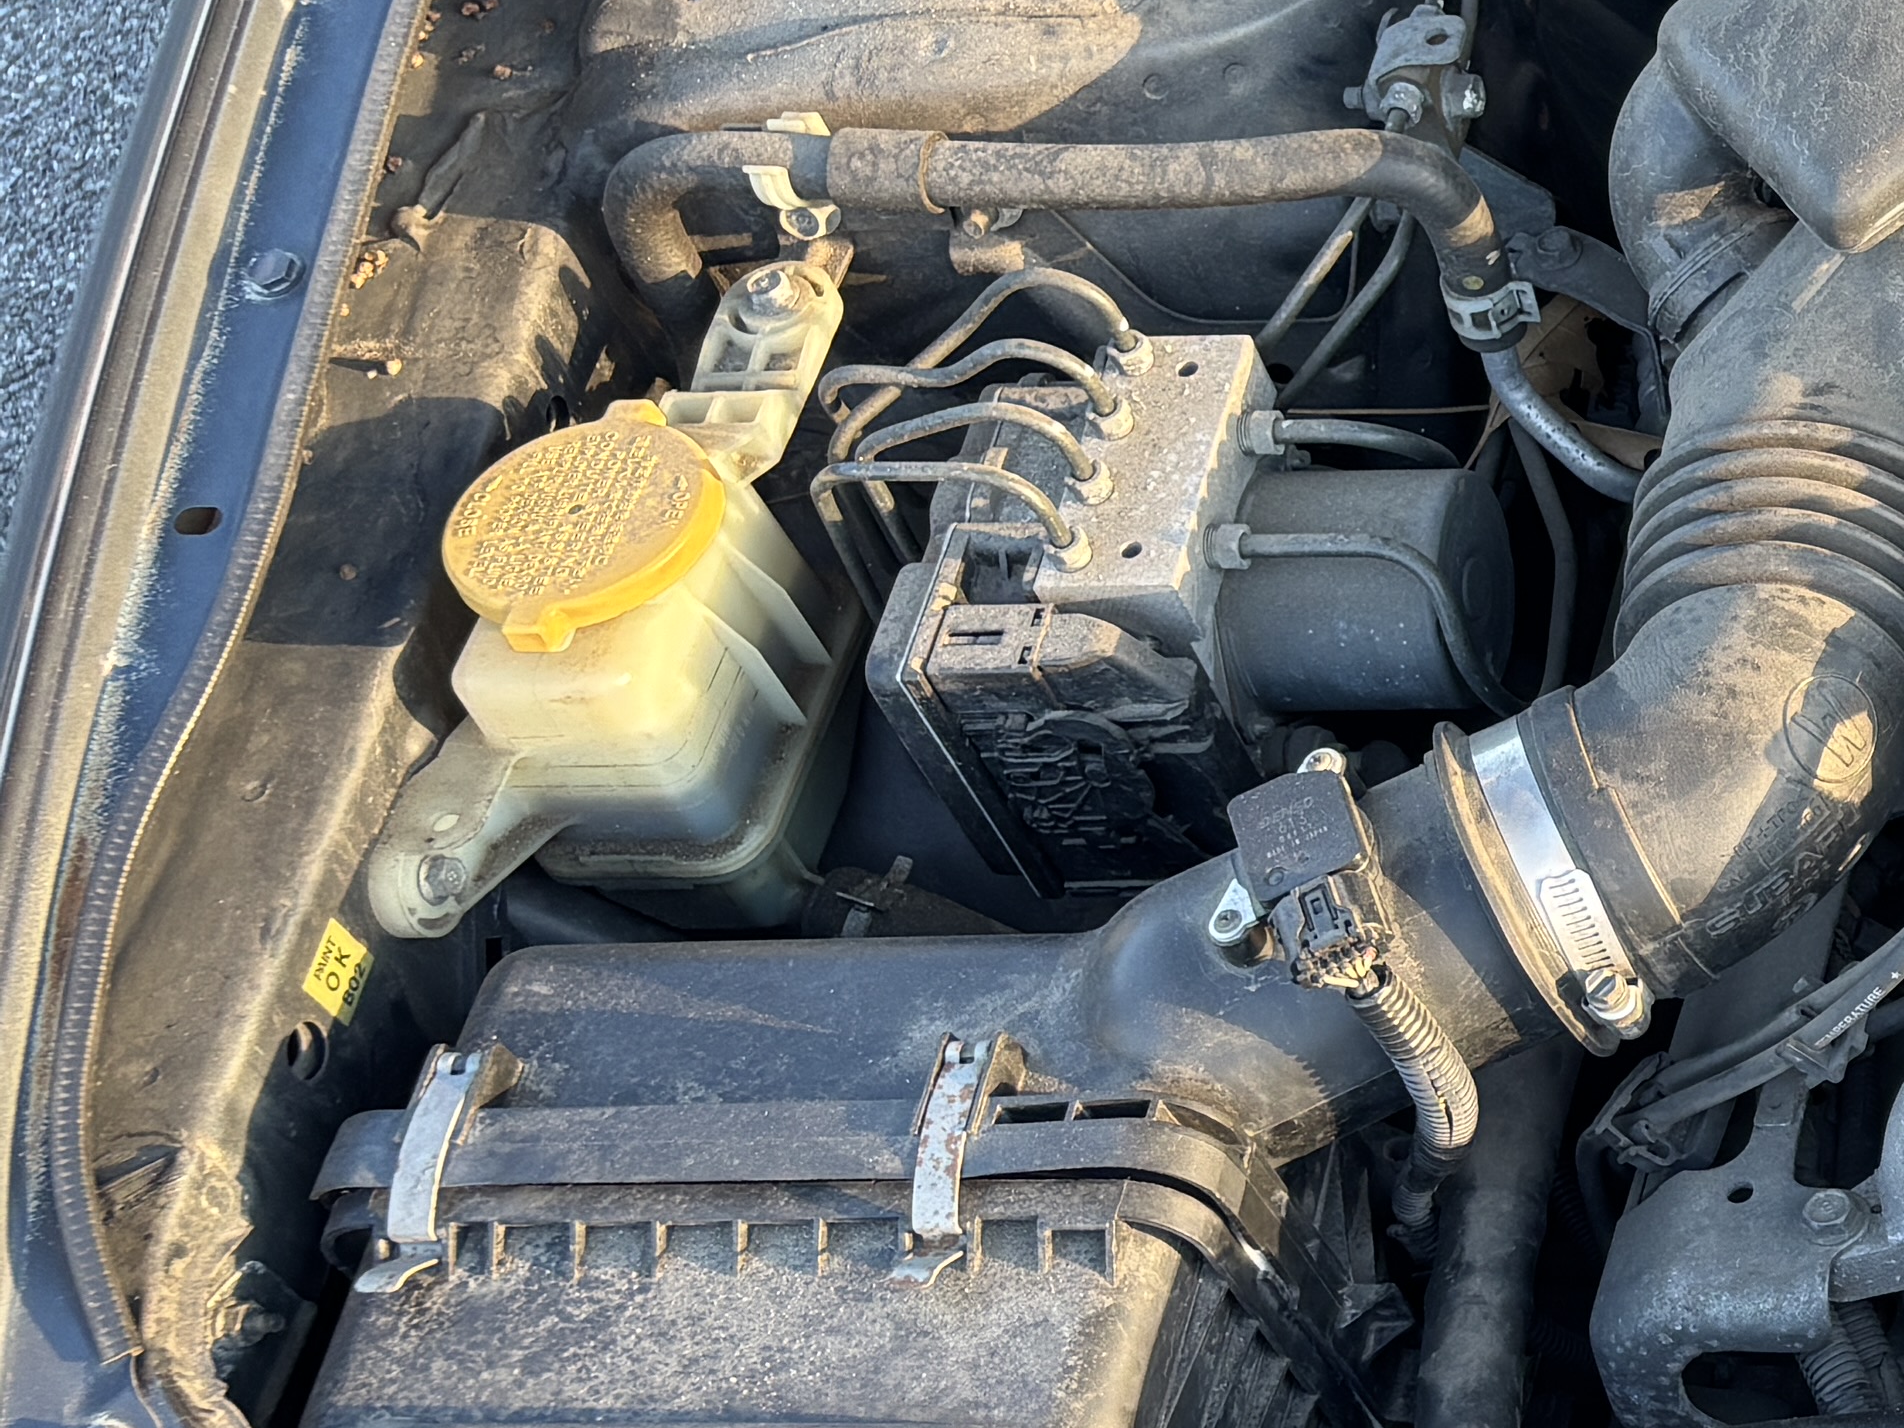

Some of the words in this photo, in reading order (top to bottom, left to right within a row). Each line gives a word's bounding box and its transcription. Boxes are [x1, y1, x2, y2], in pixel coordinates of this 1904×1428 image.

[573, 430, 619, 503] CONDUITE
[590, 449, 625, 500] POWER
[454, 490, 492, 541] CLOSE
[554, 503, 599, 577] STEERING
[527, 522, 572, 596] ASSISTEE
[313, 935, 336, 981] PAINT
